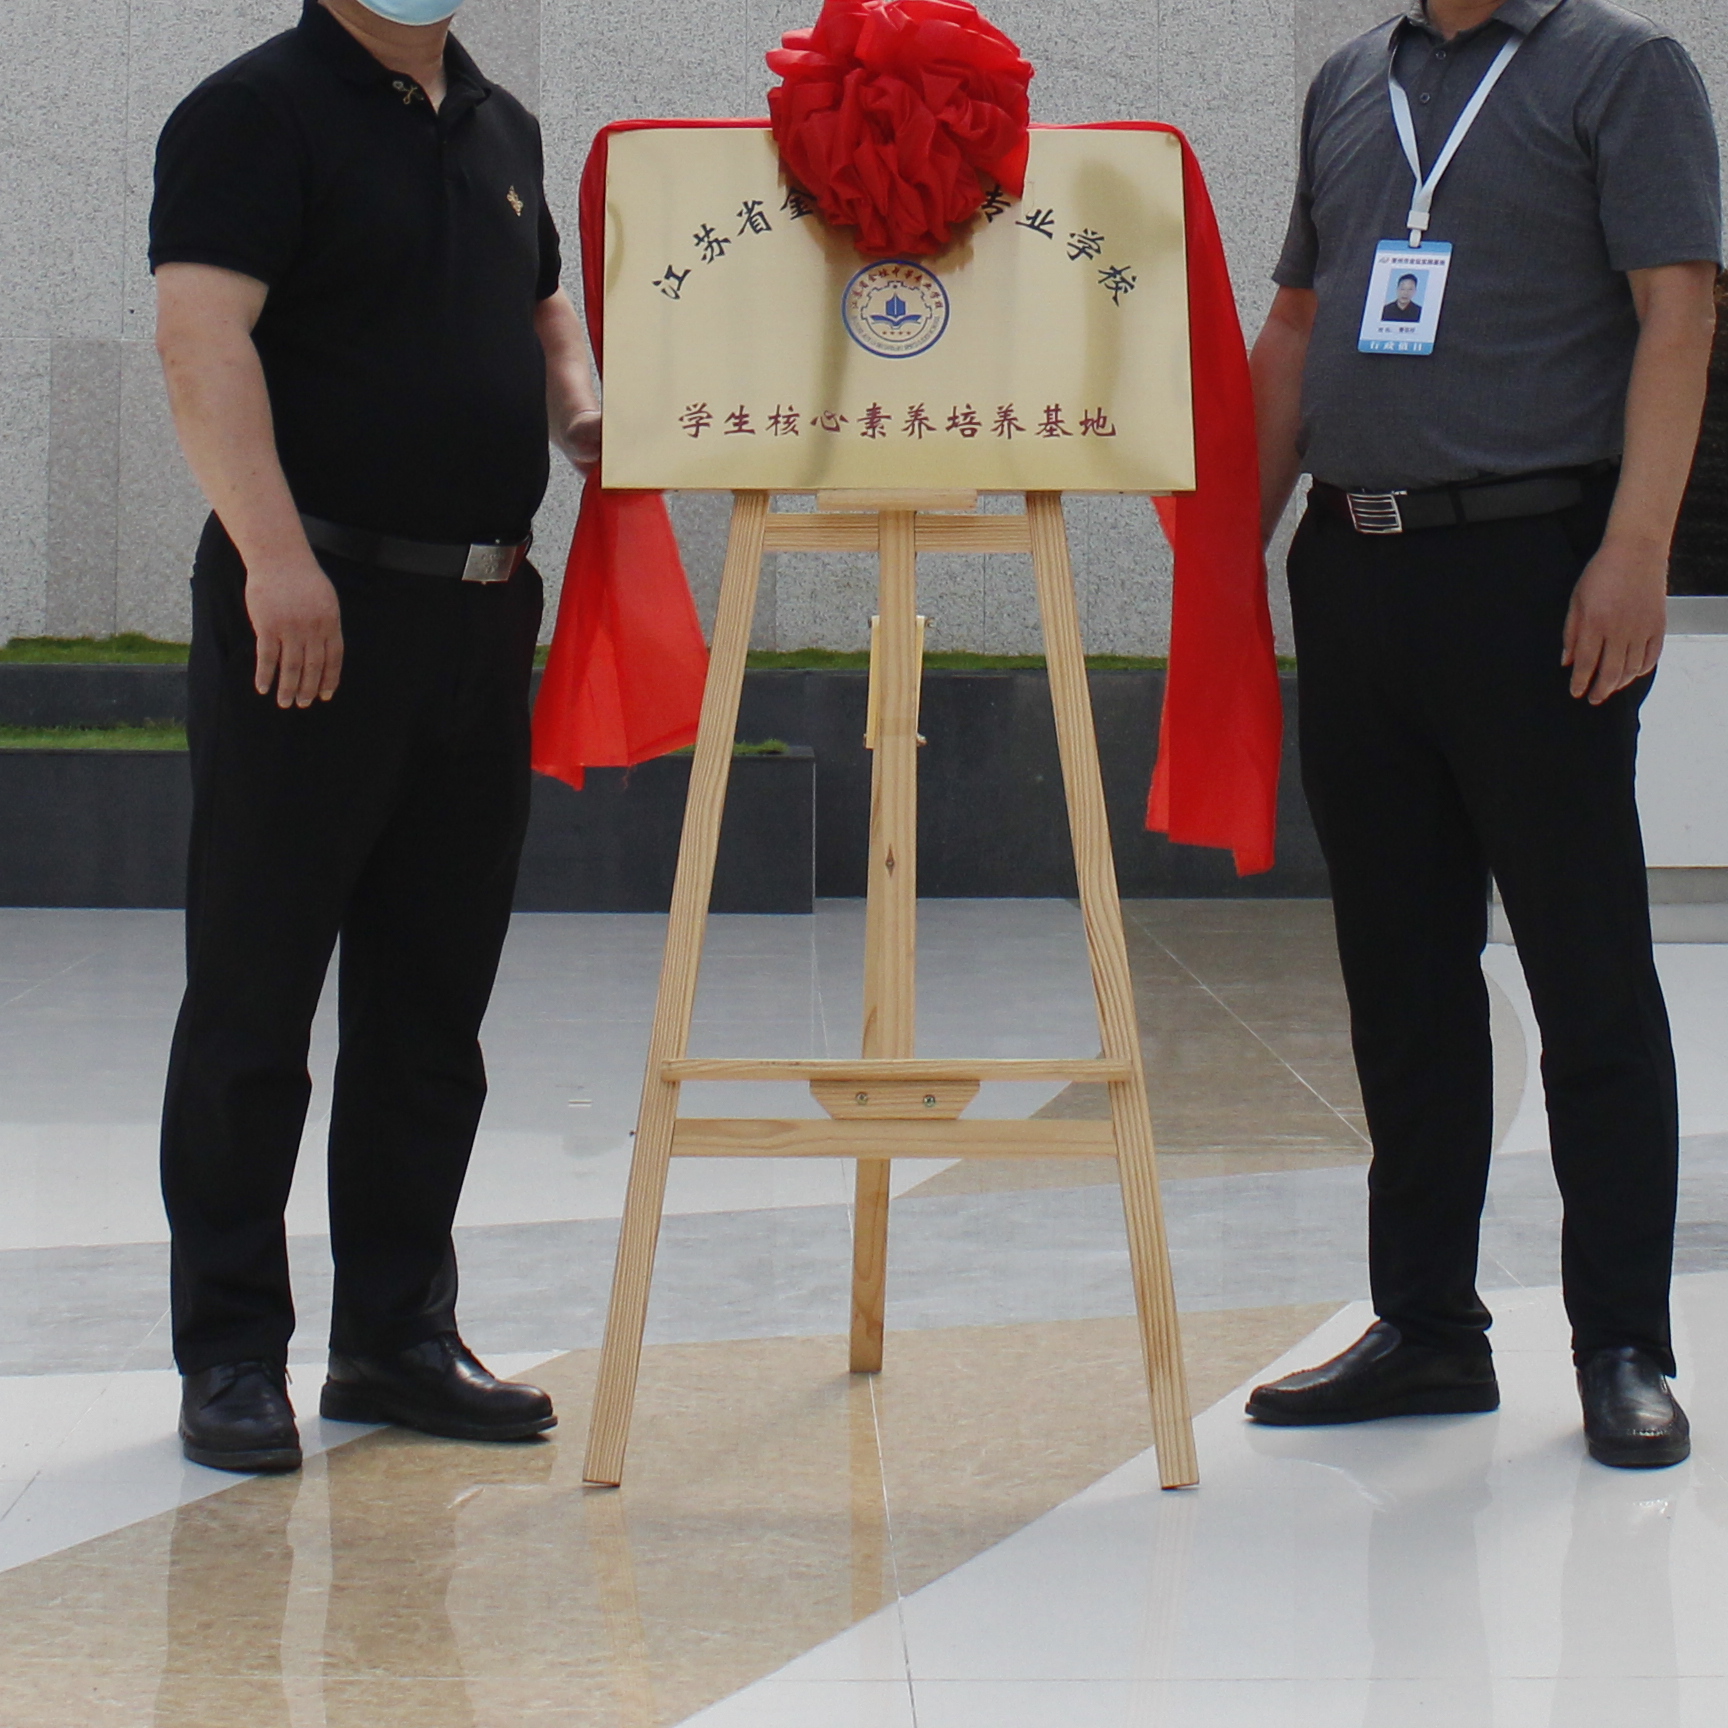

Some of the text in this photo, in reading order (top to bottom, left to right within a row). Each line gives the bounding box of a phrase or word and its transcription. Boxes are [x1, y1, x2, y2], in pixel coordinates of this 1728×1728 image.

[651, 184, 1138, 308] 江苏省金专业学校
[677, 401, 1118, 440] 学生核心素养培养基地
